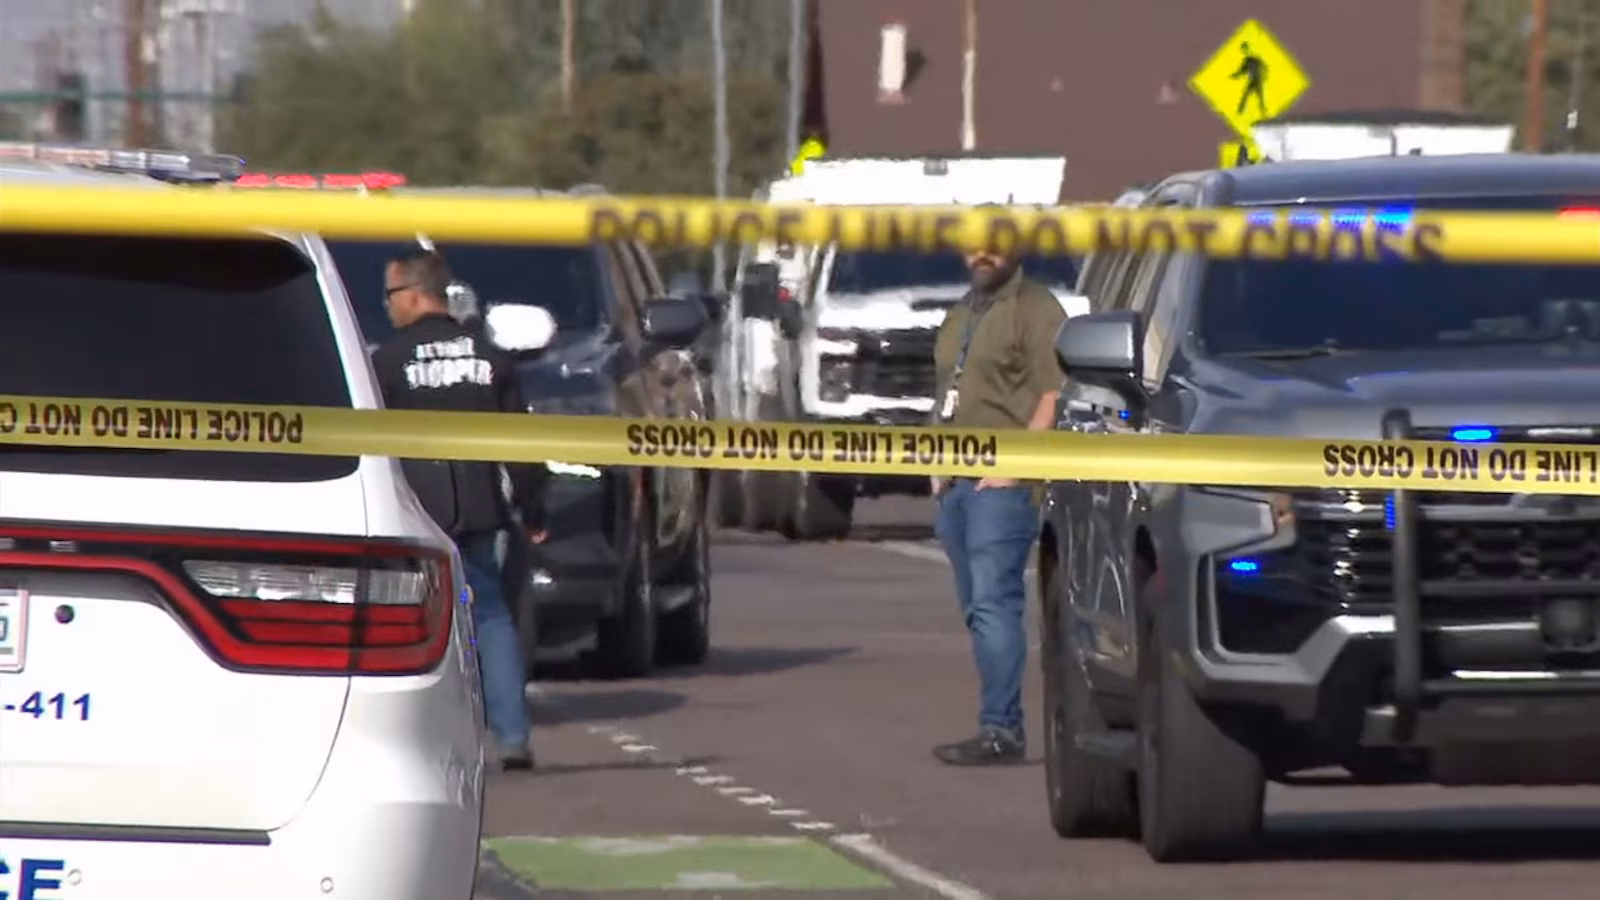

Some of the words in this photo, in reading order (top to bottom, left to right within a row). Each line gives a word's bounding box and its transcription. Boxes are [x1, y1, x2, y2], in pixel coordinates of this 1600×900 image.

[592, 208, 804, 248] POLICE
[830, 211, 960, 252] LINE
[991, 214, 1064, 254] DO
[1096, 217, 1218, 256] NOT
[25, 402, 82, 436] NOT
[91, 404, 129, 437] DO
[136, 407, 198, 440] LINE
[206, 409, 303, 443] POLICE
[627, 423, 716, 458] CROSS
[723, 427, 778, 460] NOT
[788, 429, 824, 461] DO
[833, 431, 893, 463] LINE
[901, 433, 997, 467] POLICE
[1323, 443, 1414, 478] CROSS
[1421, 446, 1478, 480] NOT
[1489, 448, 1526, 481] DO
[1535, 449, 1598, 483] LINE
